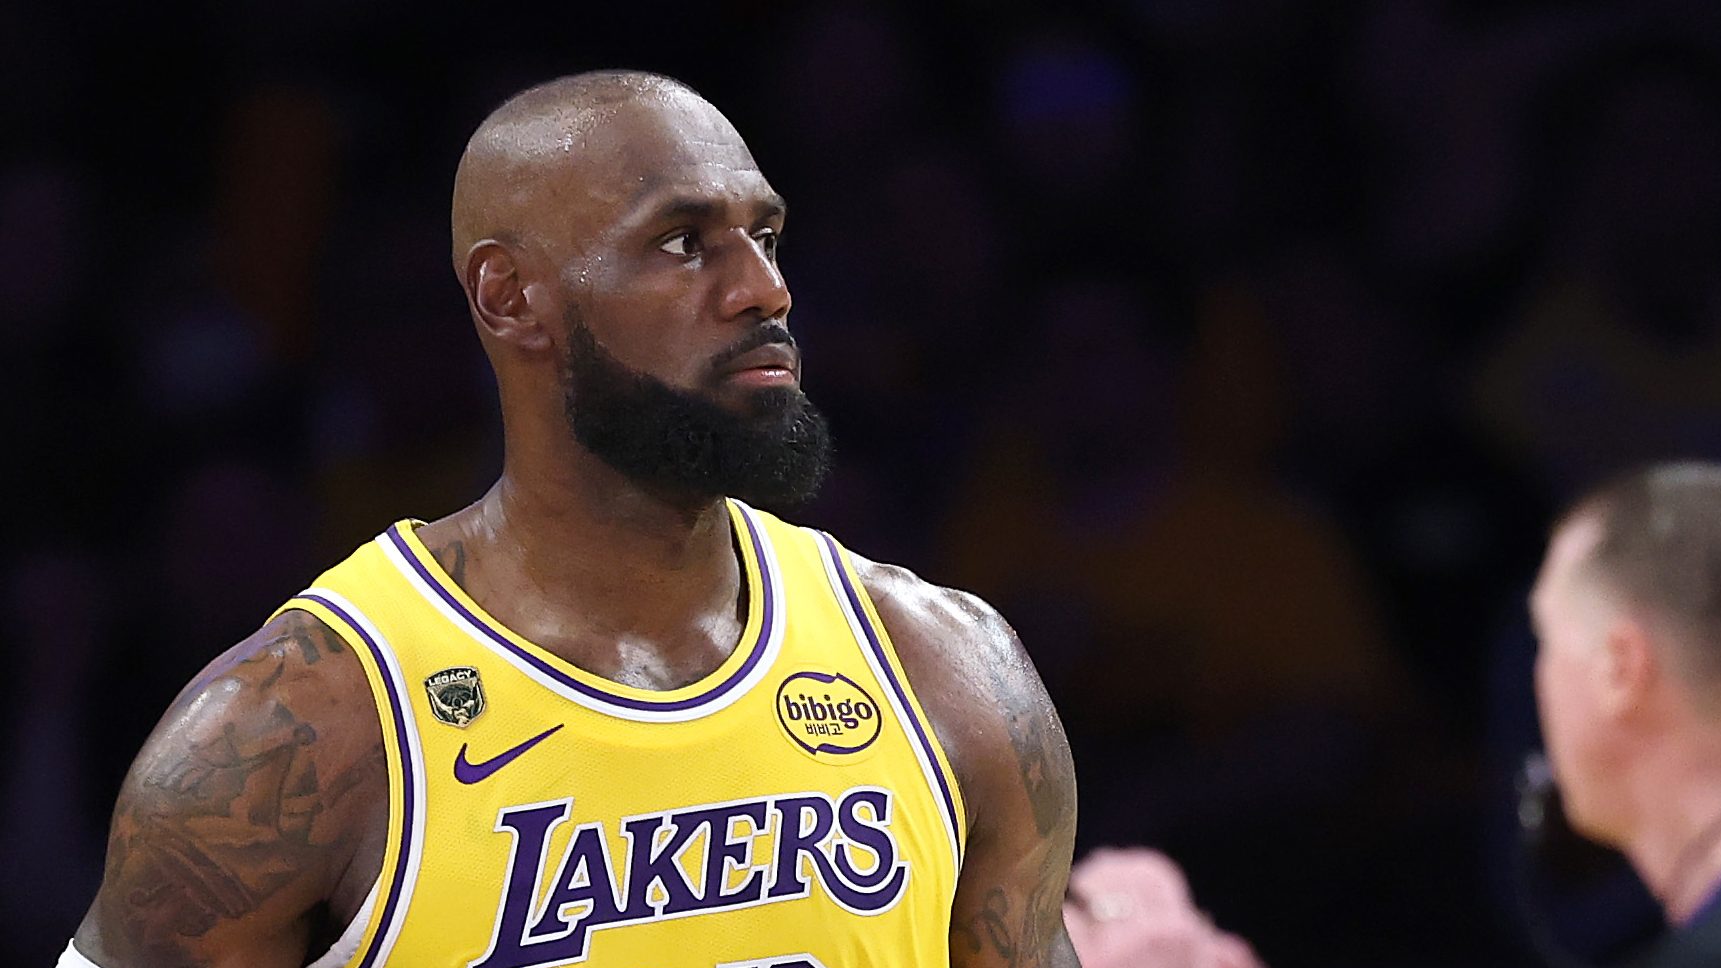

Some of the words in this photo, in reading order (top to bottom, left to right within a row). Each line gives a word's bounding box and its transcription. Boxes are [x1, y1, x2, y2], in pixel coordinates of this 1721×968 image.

[428, 669, 472, 686] LEGACY
[783, 694, 873, 729] bibigo
[804, 723, 844, 736] 비비고
